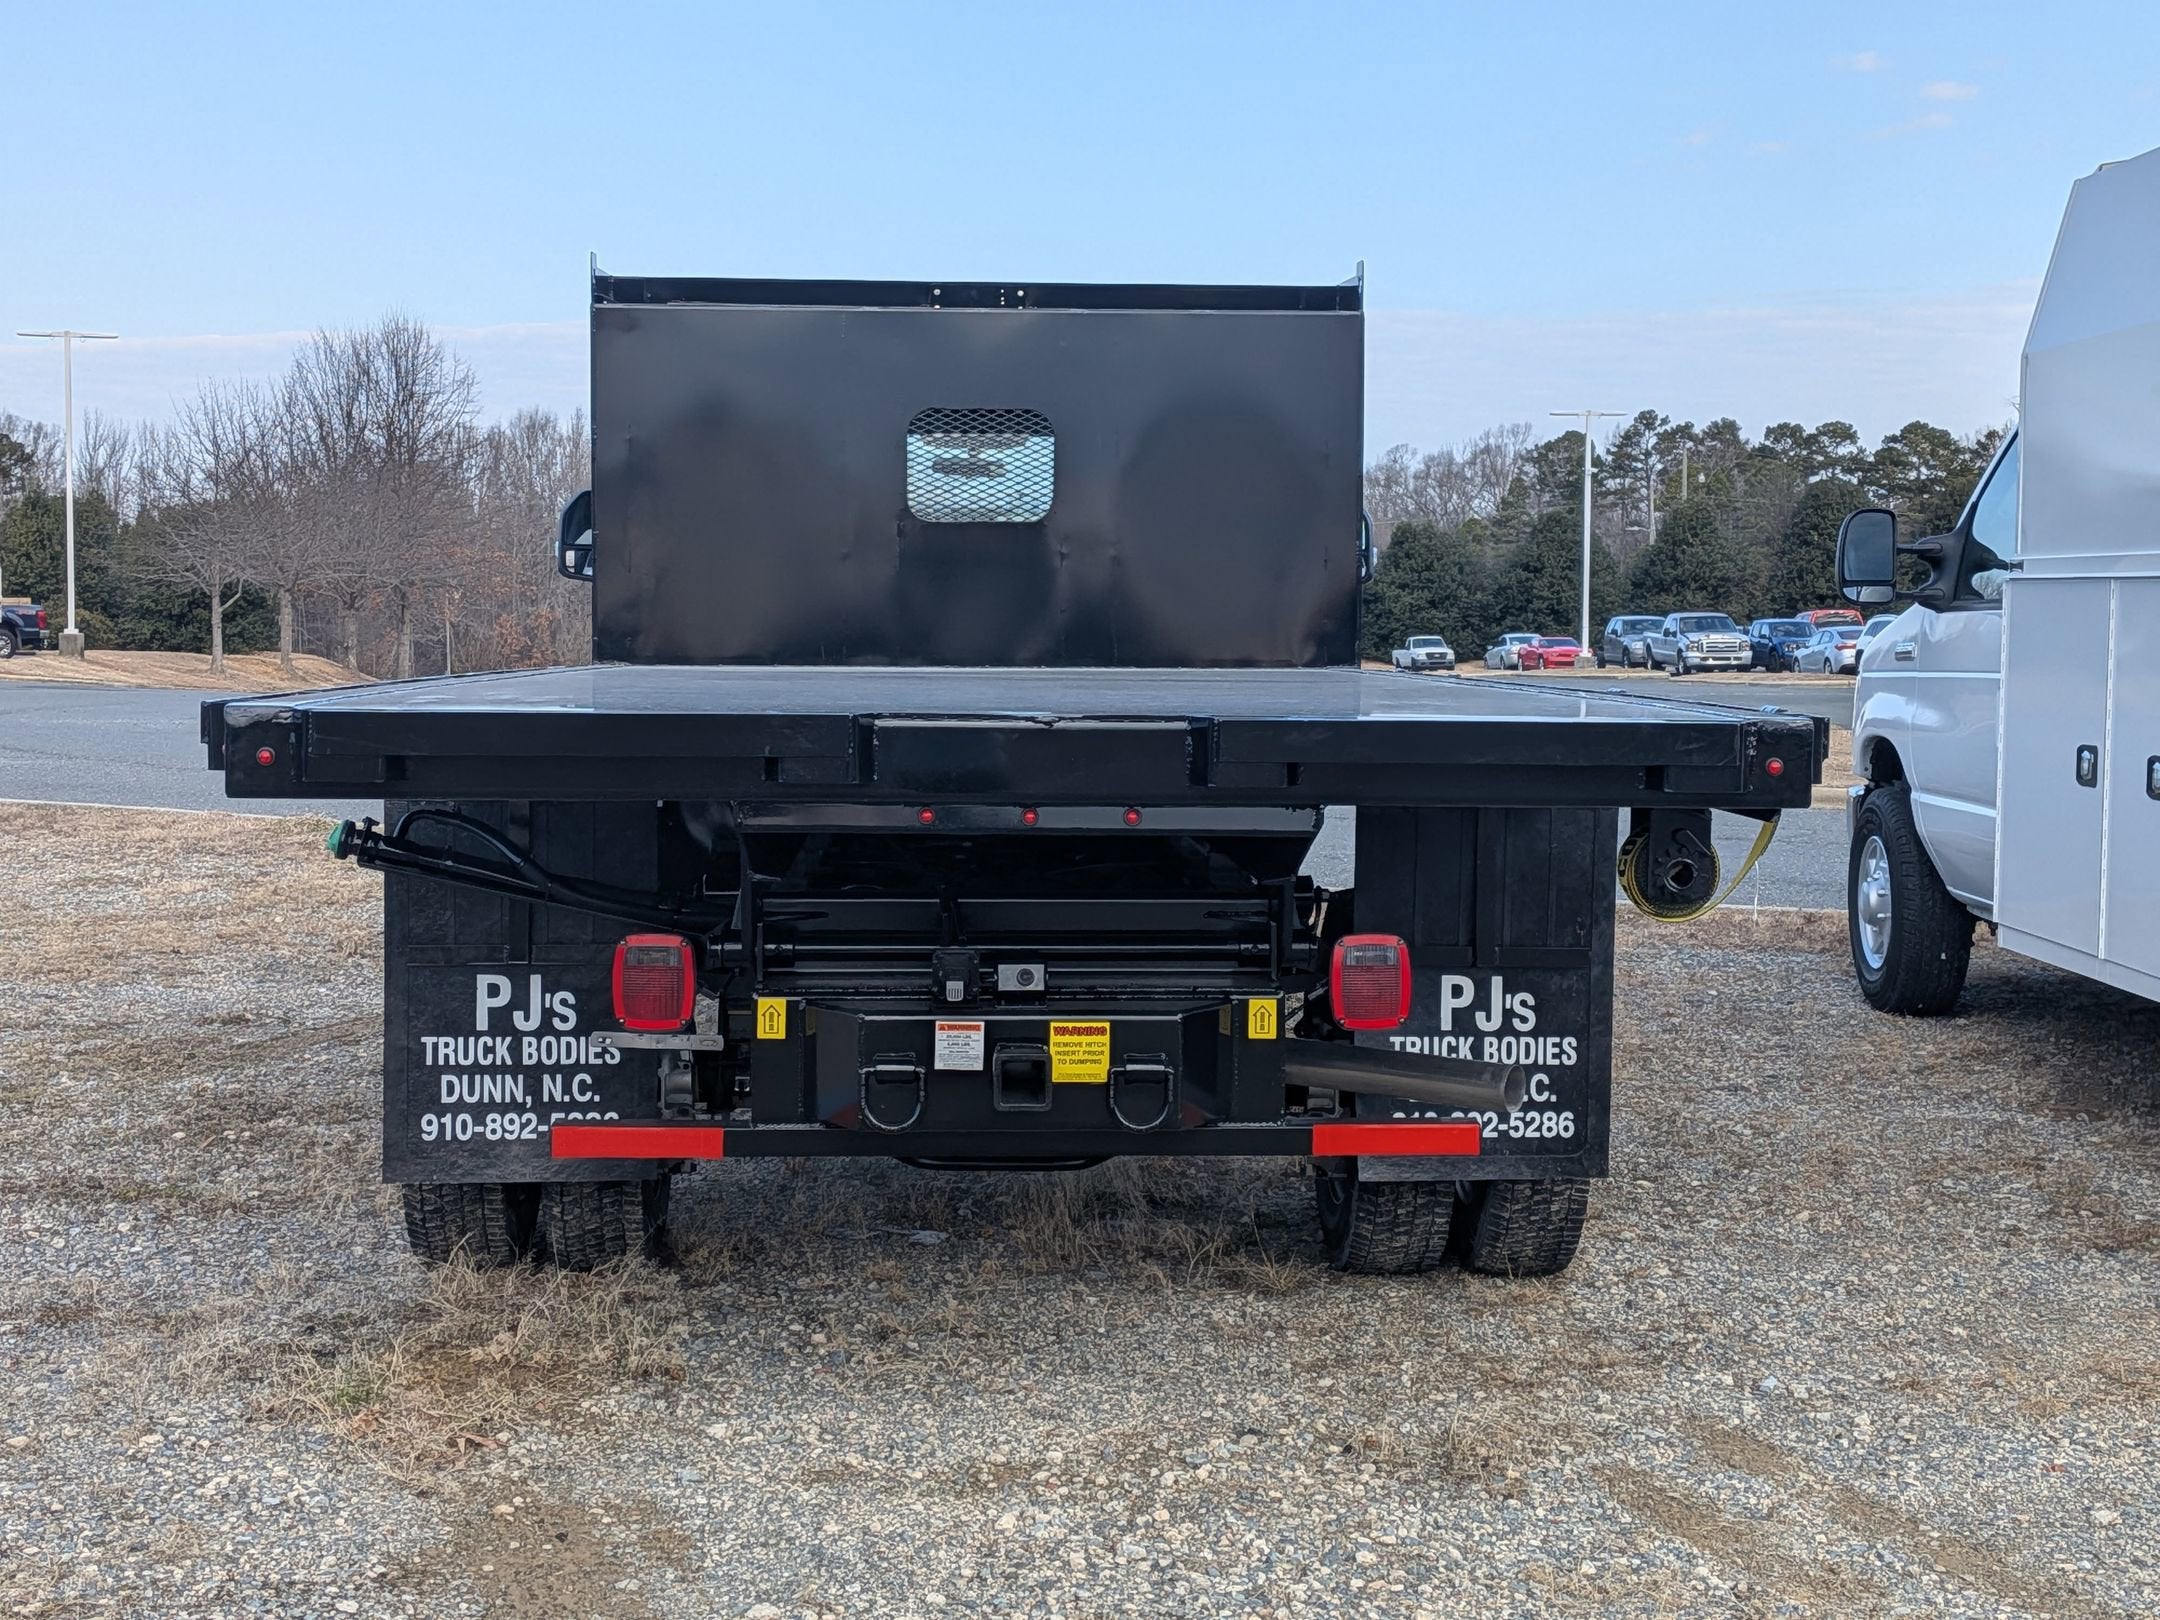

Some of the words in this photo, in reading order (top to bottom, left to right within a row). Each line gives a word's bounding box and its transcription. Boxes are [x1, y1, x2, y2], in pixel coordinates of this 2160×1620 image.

[1053, 1026, 1107, 1037] WARNING
[421, 1036, 513, 1065] TRUCK
[522, 1036, 621, 1065] BODIES
[1483, 1036, 1578, 1065] BODIES
[441, 1074, 532, 1108] DUNN,
[542, 1073, 601, 1103] N.C.
[1522, 1073, 1557, 1103] .C.
[420, 1111, 620, 1141] 910-892-
